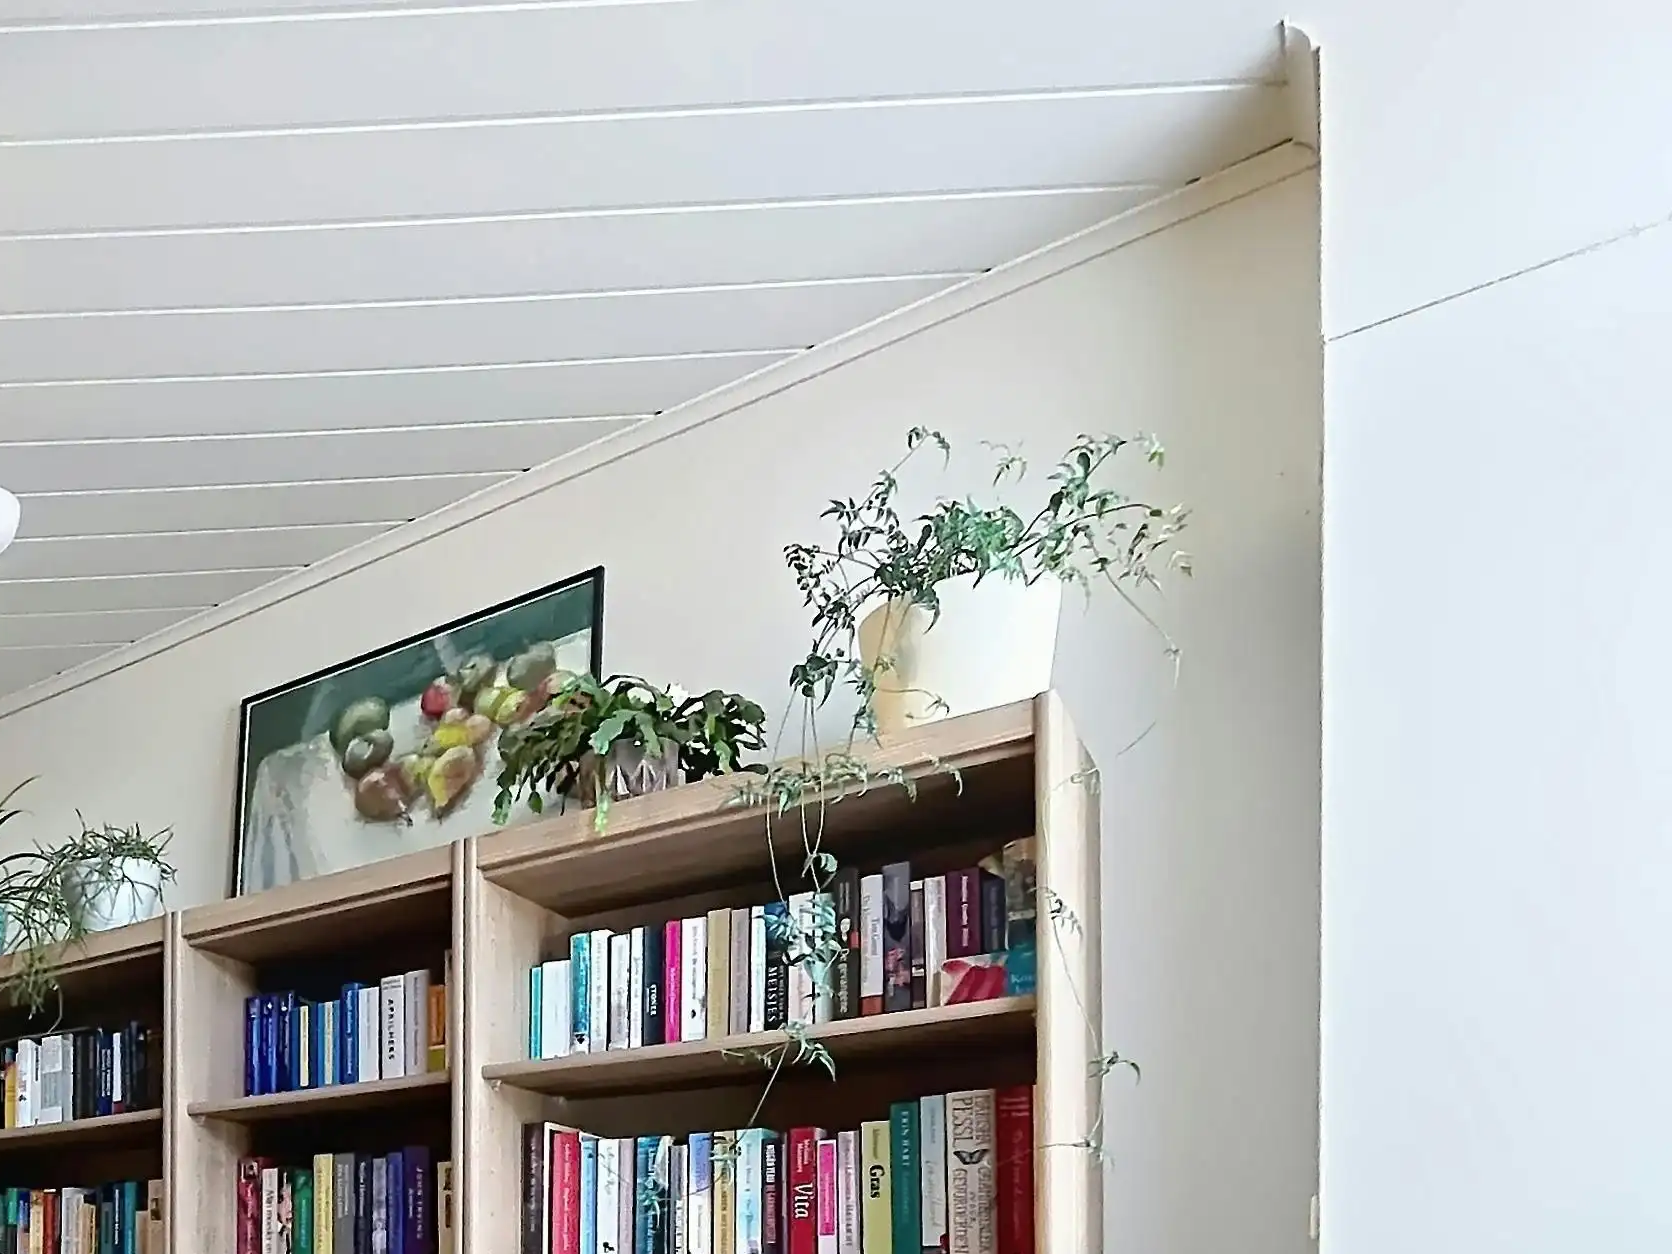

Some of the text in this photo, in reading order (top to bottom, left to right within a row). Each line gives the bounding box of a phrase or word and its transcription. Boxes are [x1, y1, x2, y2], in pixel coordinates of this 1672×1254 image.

[768, 967, 778, 1023] MEISJES
[952, 1097, 973, 1148] PESSL
[794, 1183, 814, 1218] Vita
[870, 1165, 885, 1198] Gras
